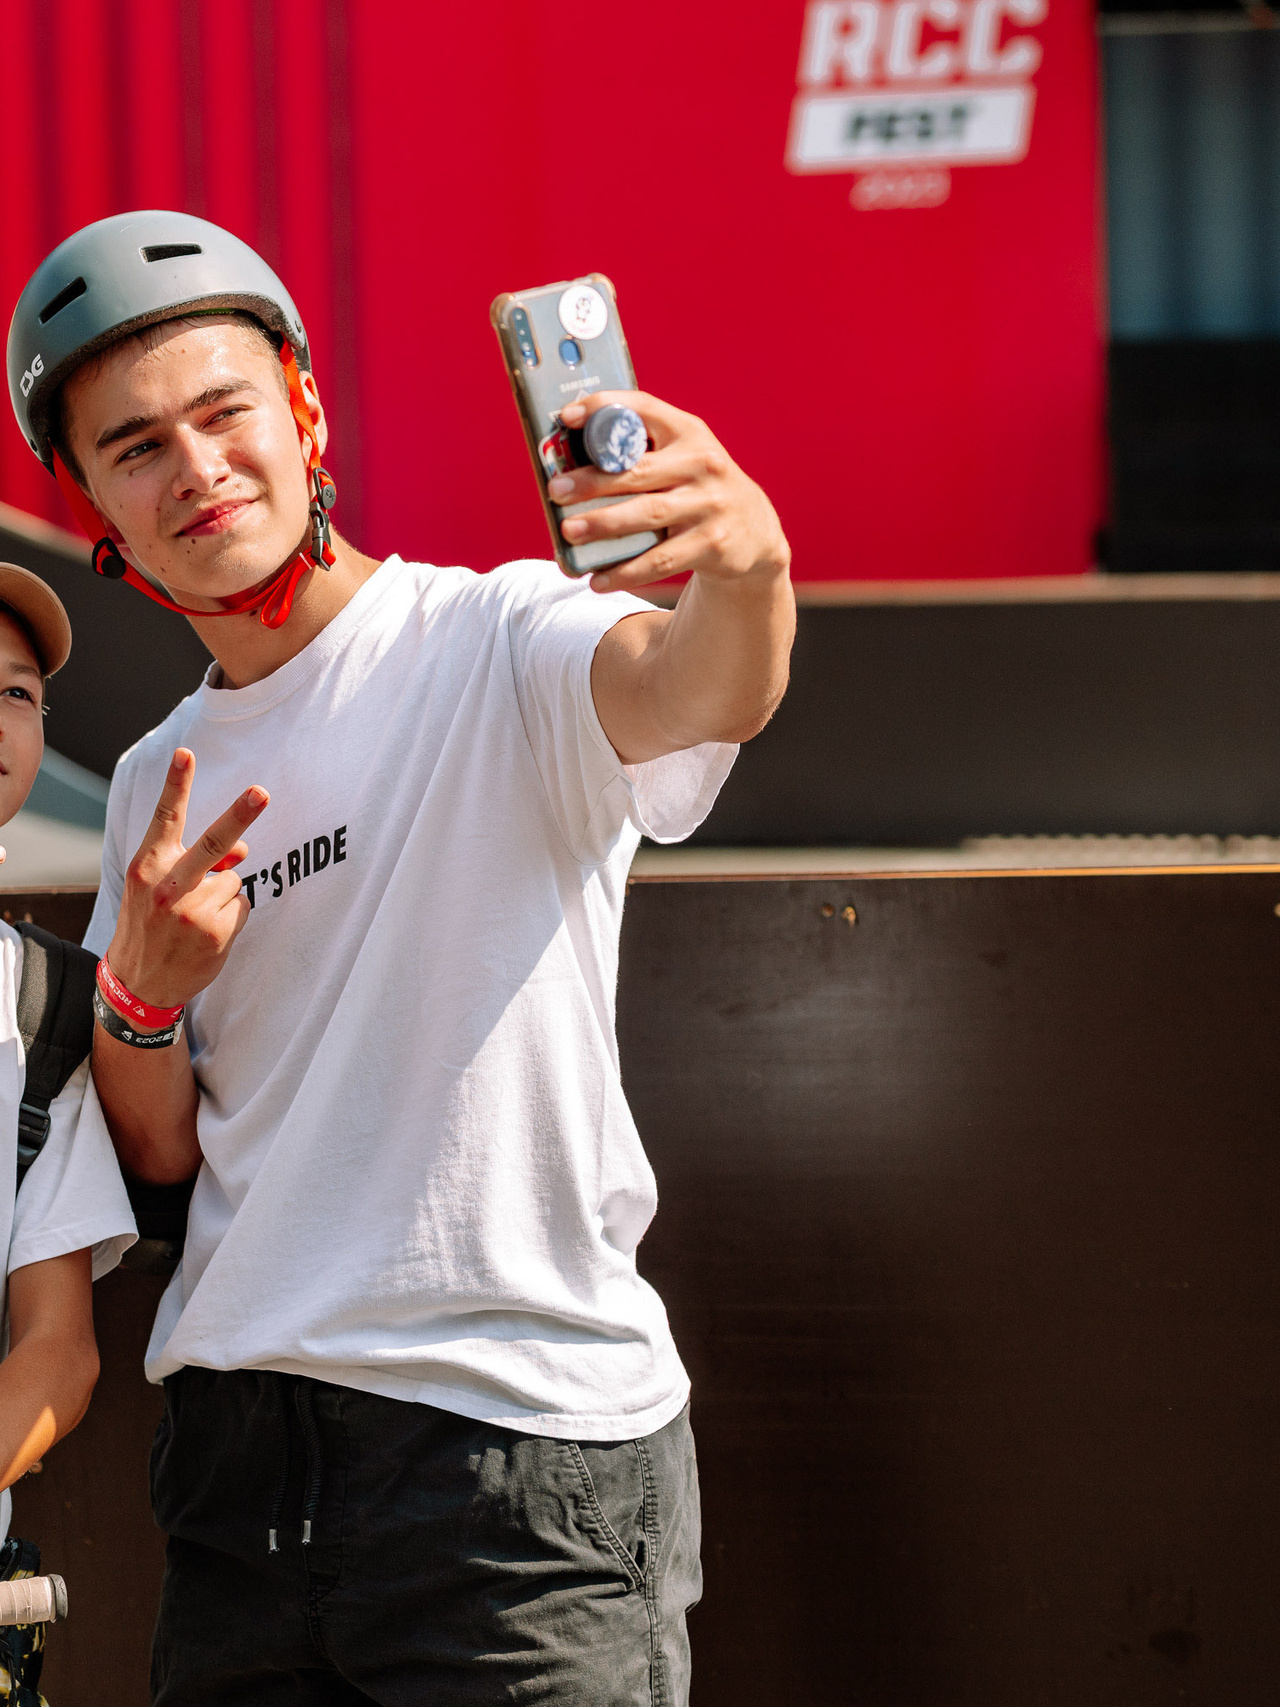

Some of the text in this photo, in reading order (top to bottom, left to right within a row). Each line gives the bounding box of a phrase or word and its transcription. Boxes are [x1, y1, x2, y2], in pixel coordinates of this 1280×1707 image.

[799, 0, 1050, 82] RCC
[844, 102, 976, 150] FEST
[287, 824, 347, 888] RIDE
[113, 985, 132, 1007] RCC
